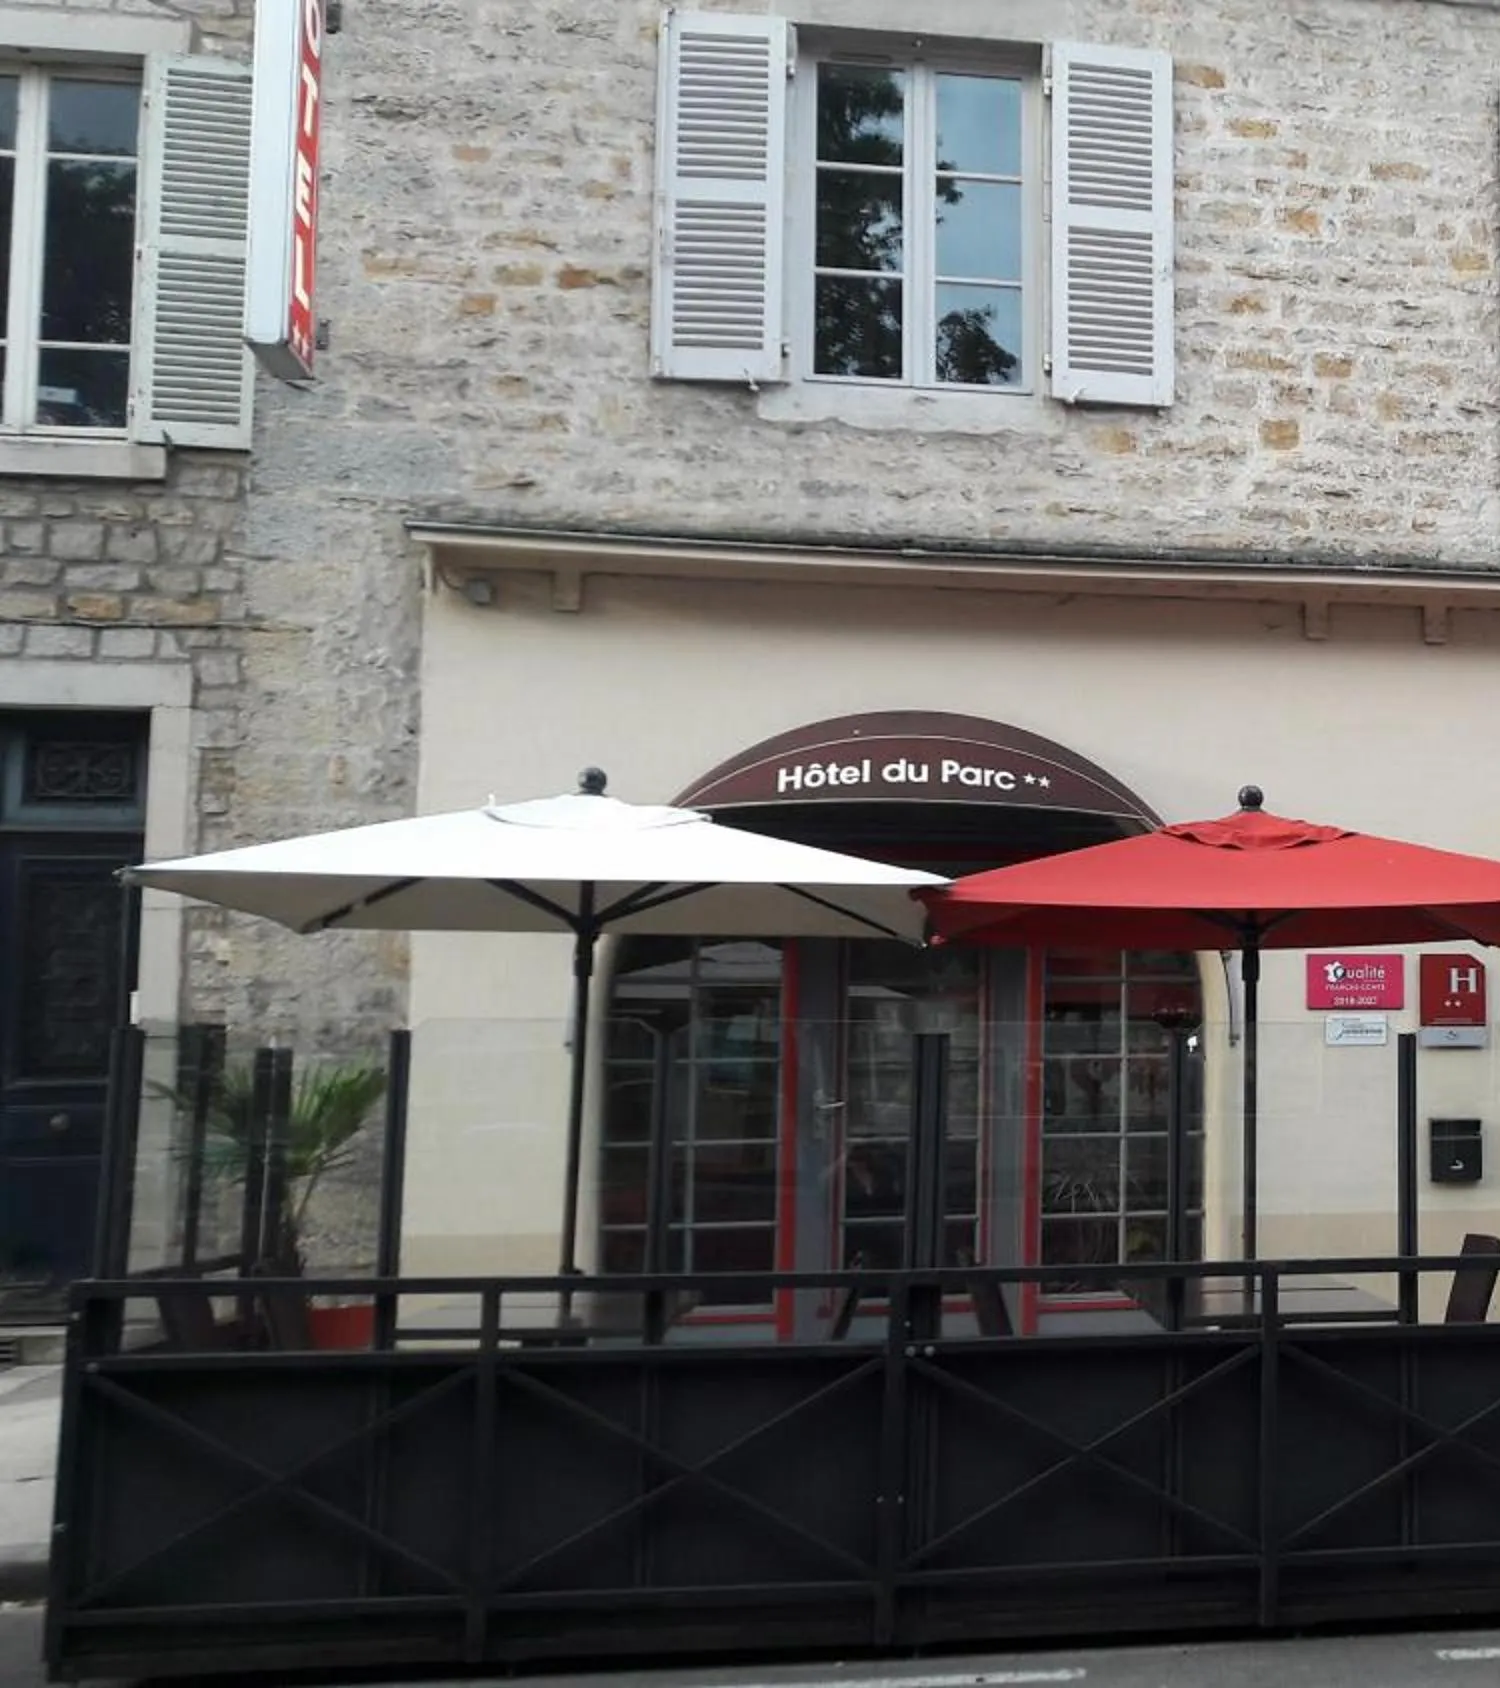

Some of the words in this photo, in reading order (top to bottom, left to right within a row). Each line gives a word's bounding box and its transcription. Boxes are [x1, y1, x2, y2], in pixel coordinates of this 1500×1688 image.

[295, 0, 321, 311] OTEL
[776, 759, 871, 793] Hôtel
[881, 758, 929, 785] du
[941, 759, 1017, 791] Parc
[1450, 967, 1477, 993] H
